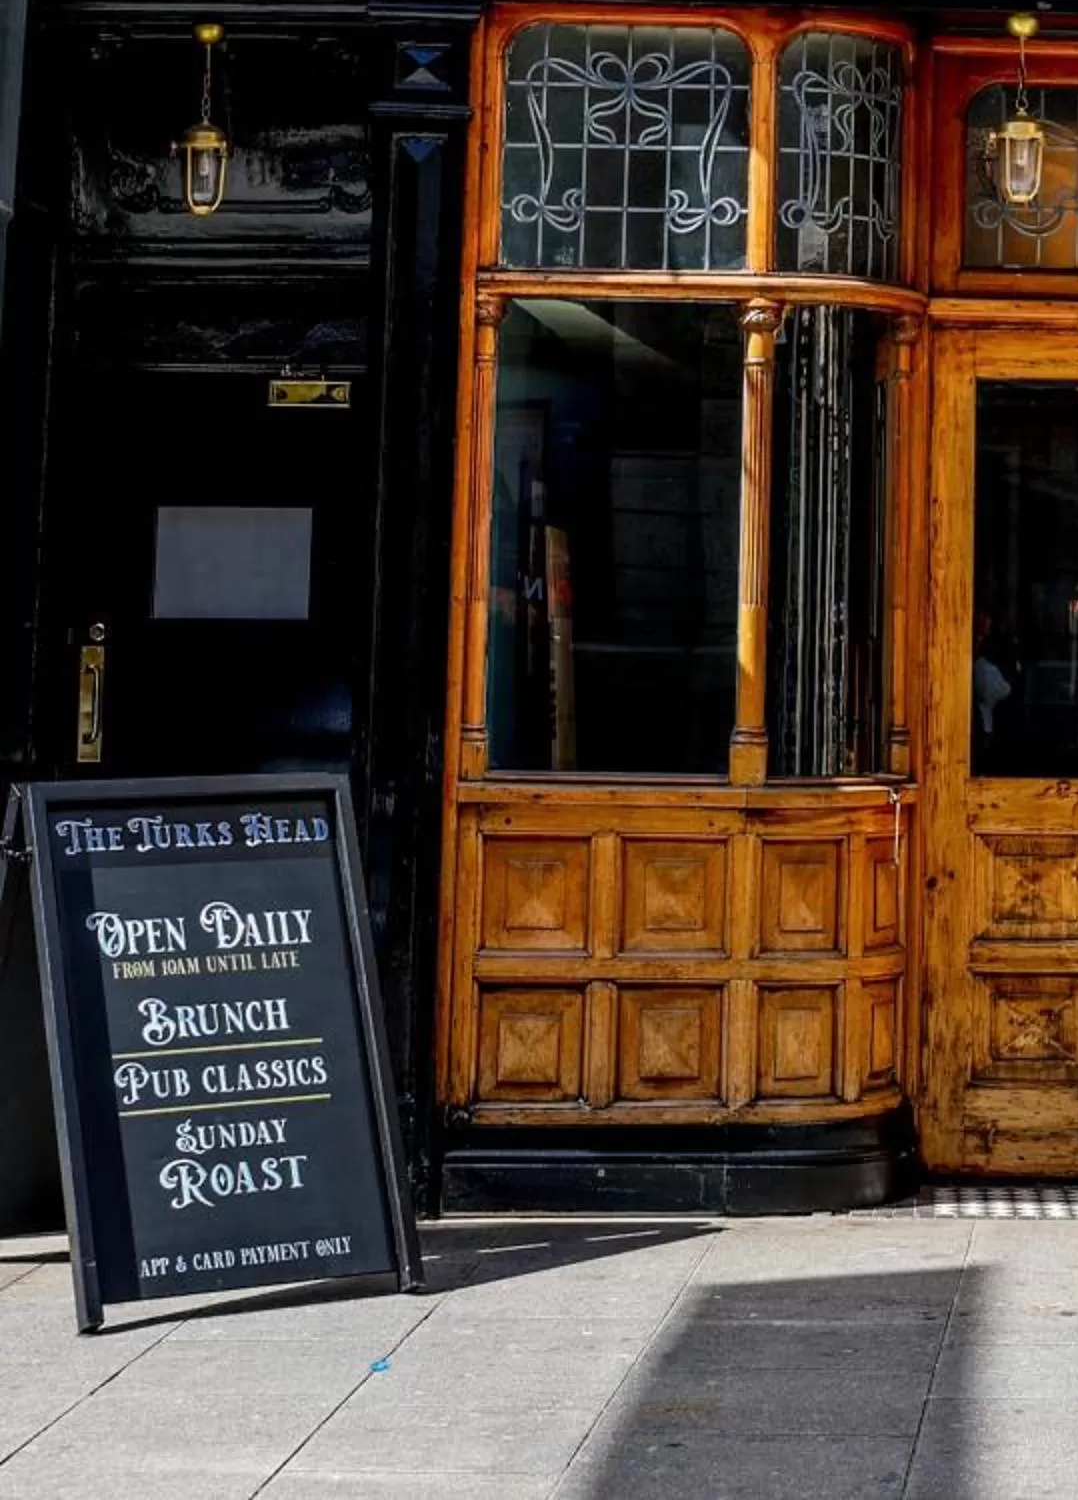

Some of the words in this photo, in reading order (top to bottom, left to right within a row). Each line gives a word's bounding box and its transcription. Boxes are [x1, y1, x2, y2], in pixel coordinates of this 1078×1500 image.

[56, 817, 125, 855] THE
[127, 815, 234, 852] TURKS
[240, 812, 329, 848] HEAD
[85, 911, 187, 957] OPEN
[200, 901, 312, 949] DAILY
[112, 961, 156, 979] FROM
[161, 957, 200, 976] 10AM
[206, 953, 257, 972] UNTIL
[261, 950, 301, 970] LATE
[137, 997, 291, 1046] BRUNCH
[113, 1062, 191, 1105] PUB
[202, 1056, 328, 1093] CLASSICS
[175, 1118, 288, 1155] SUNDAY
[159, 1155, 308, 1209] ROAST
[139, 1257, 170, 1279] APP
[175, 1256, 188, 1273] &
[193, 1249, 236, 1272] CARD
[241, 1240, 311, 1266] PAYMENT
[315, 1235, 352, 1257] ONLY
